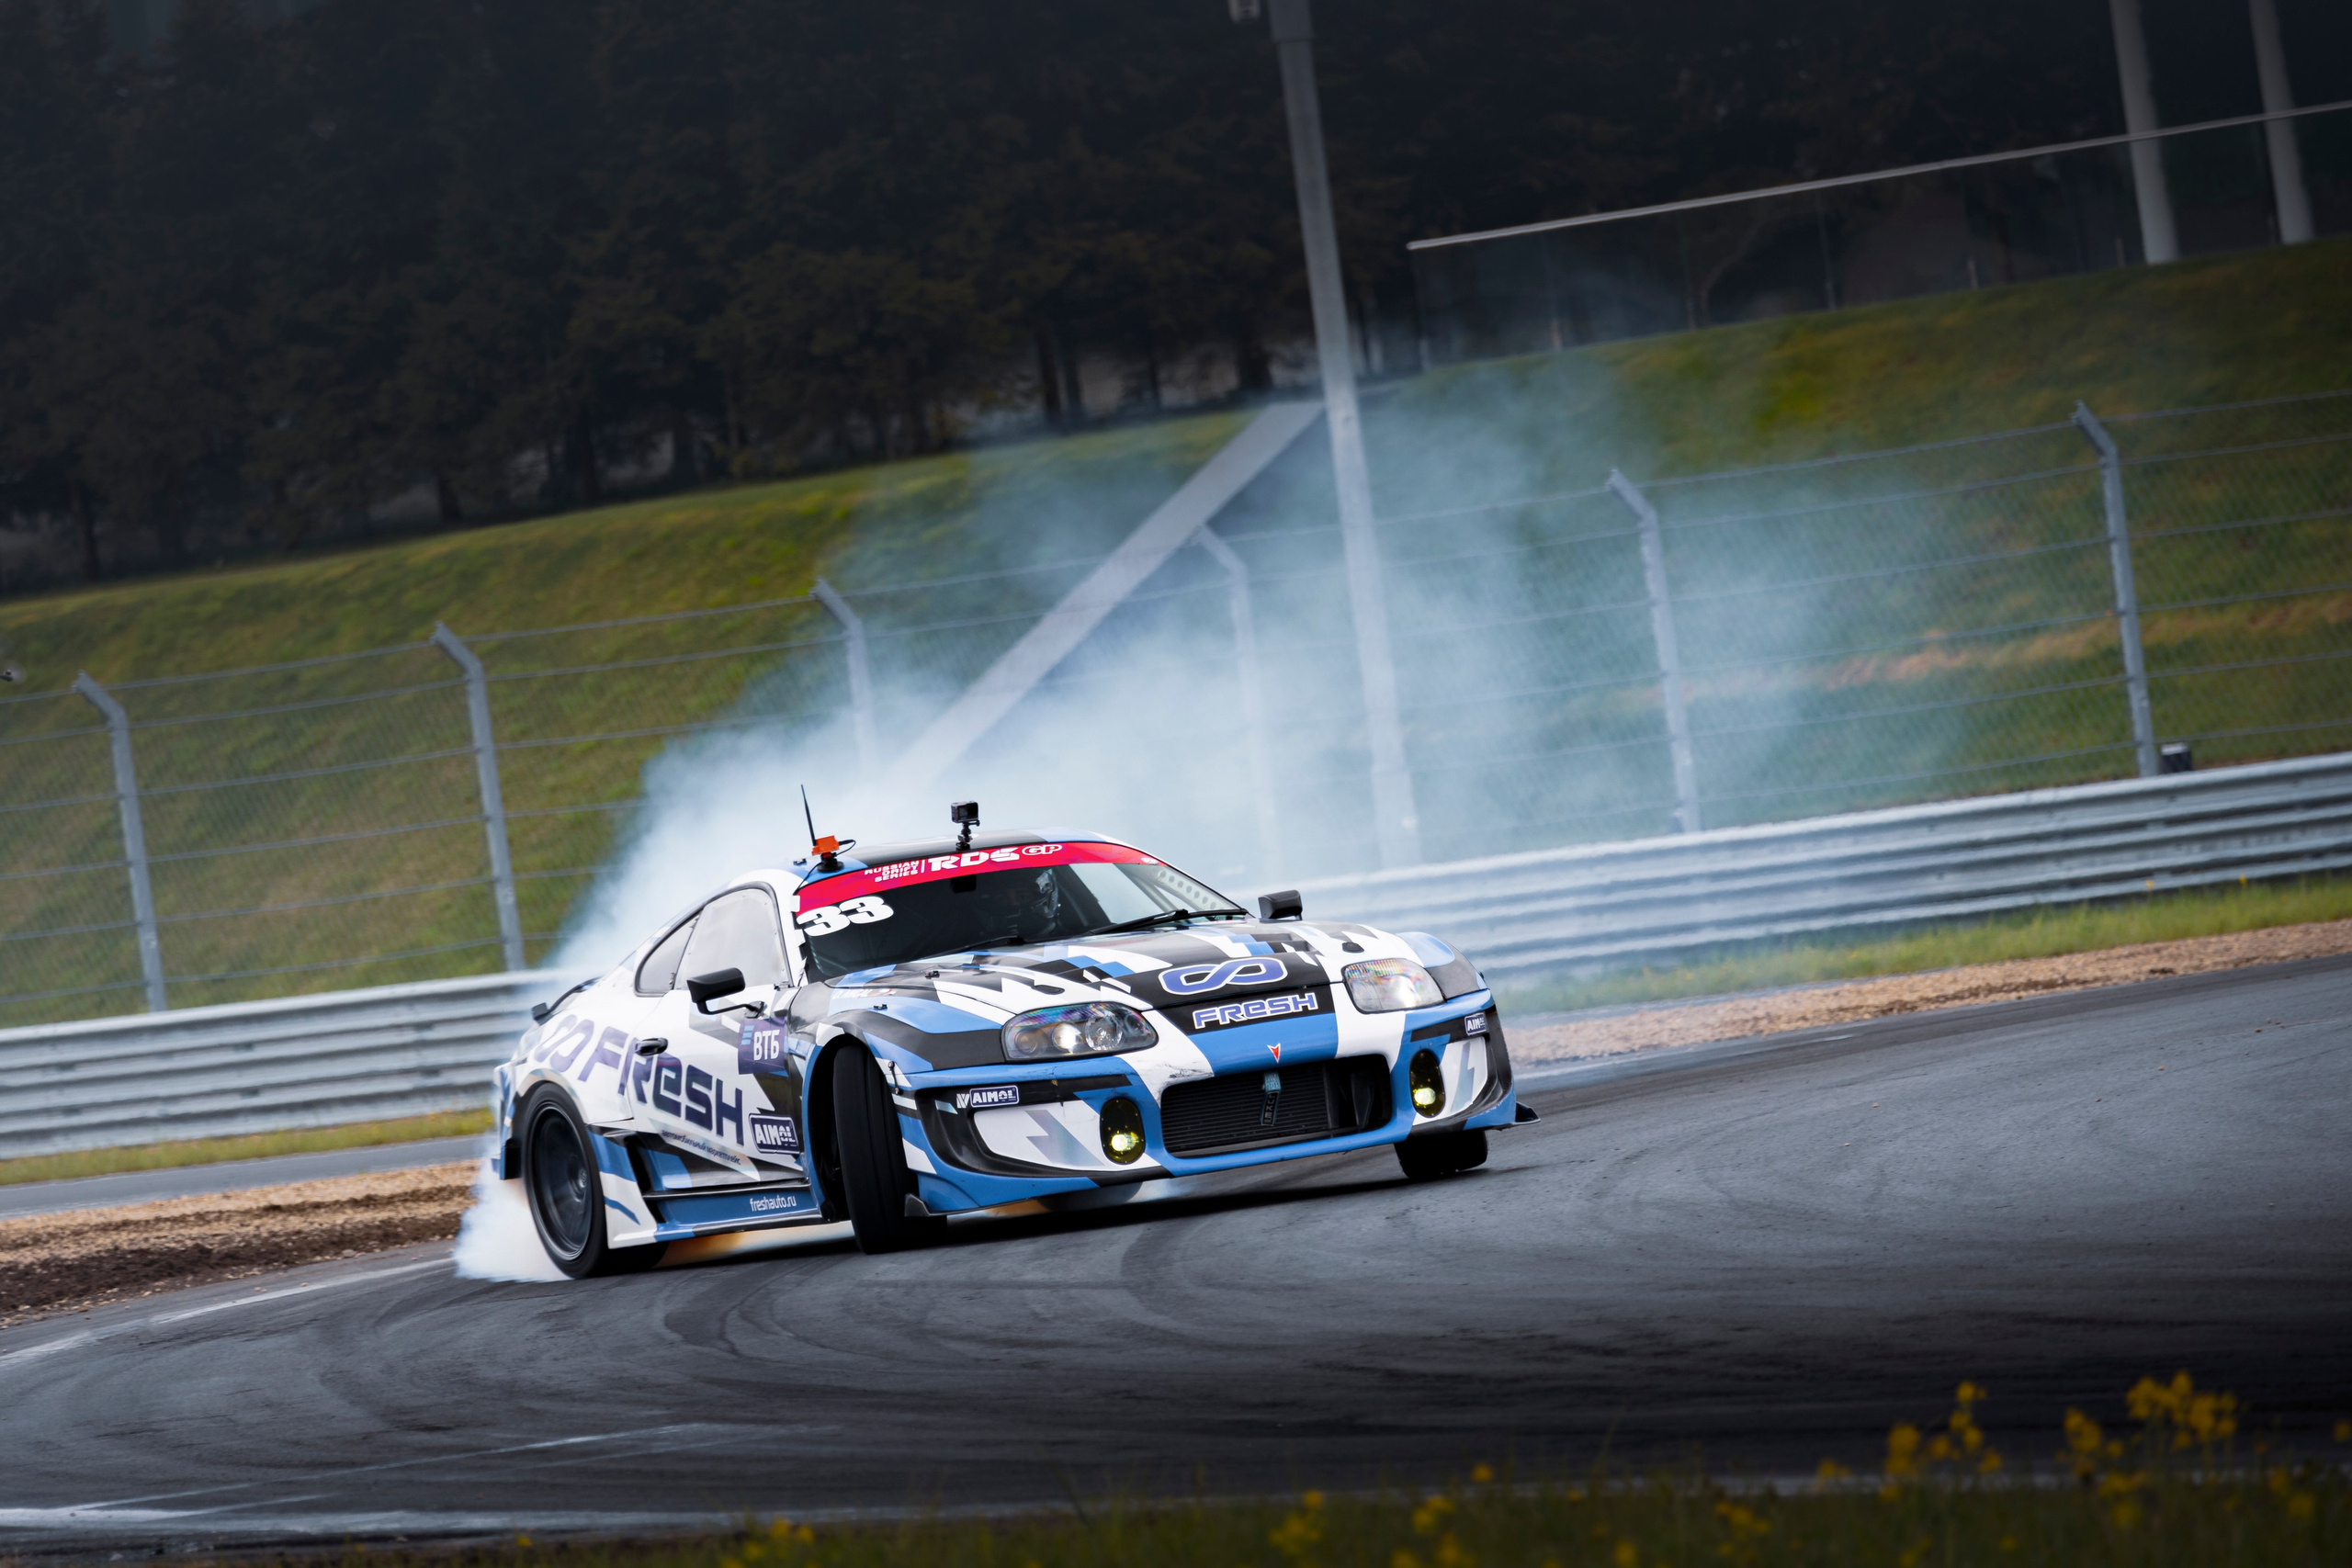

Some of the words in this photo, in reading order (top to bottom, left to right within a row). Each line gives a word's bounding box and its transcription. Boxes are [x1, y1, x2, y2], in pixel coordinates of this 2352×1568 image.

[928, 847, 1020, 872] RDS
[1022, 844, 1062, 856] GP
[864, 860, 919, 875] RUSSIAN
[875, 870, 918, 883] SERIES
[882, 865, 918, 876] DRIFT
[797, 897, 894, 936] 33
[753, 1029, 780, 1061] ВТБ
[972, 1089, 1016, 1104] AIMOL
[754, 1123, 797, 1145] AIMOL
[750, 1195, 797, 1213] freshauto.ru
